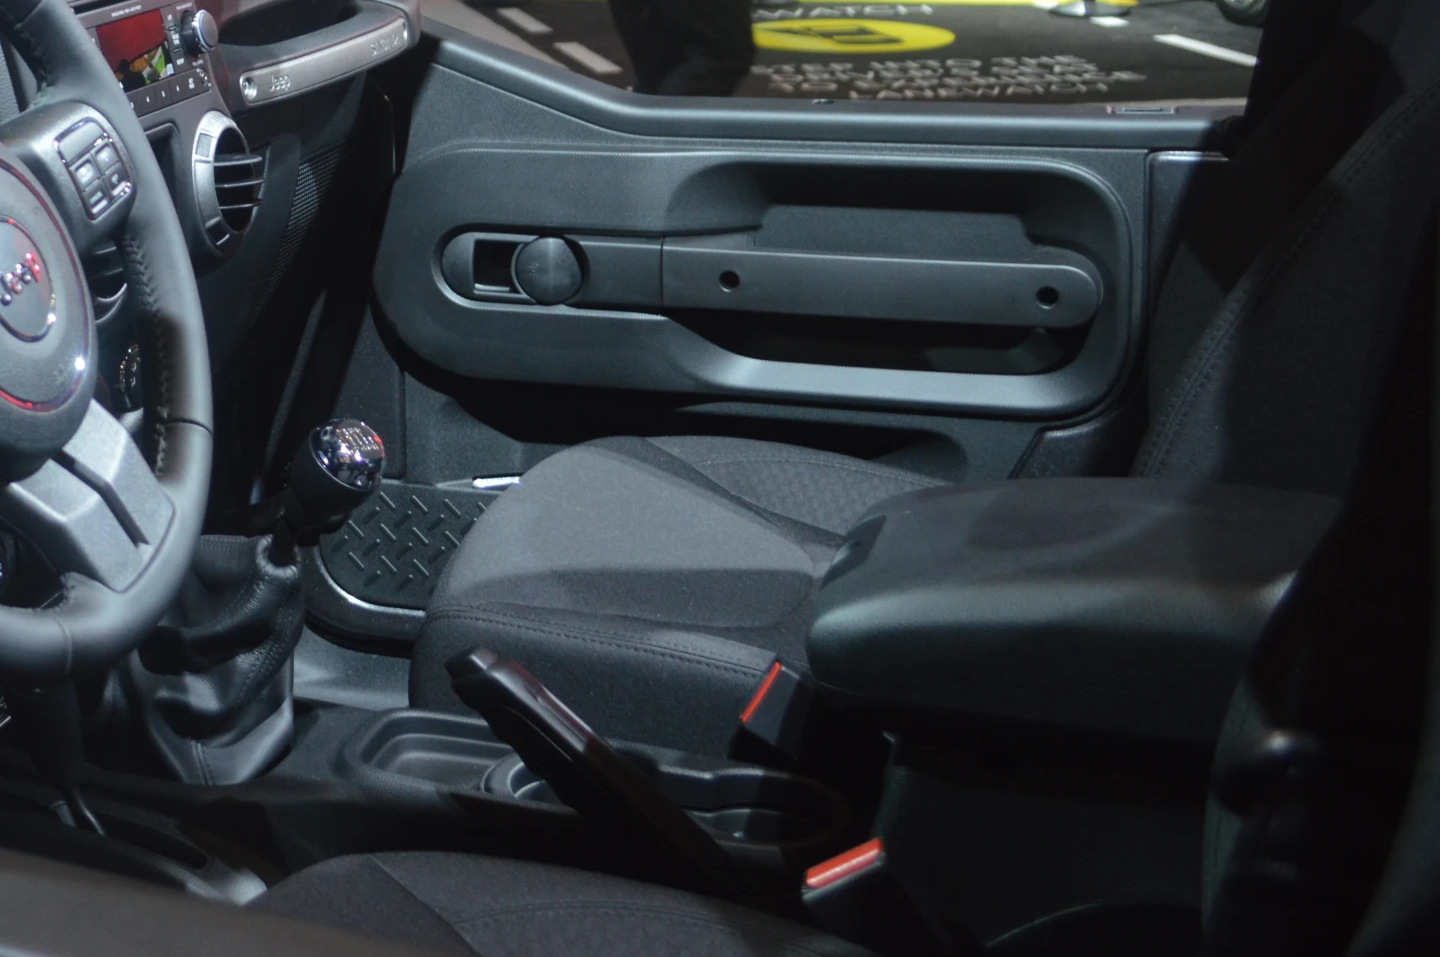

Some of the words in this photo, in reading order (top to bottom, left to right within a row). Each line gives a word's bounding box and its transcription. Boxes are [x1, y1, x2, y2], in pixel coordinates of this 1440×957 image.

[752, 4, 934, 20] WATCH
[870, 58, 983, 71] INTO
[269, 73, 291, 92] Jeep
[769, 81, 839, 94] TO
[848, 83, 1108, 100] LANEWATCH
